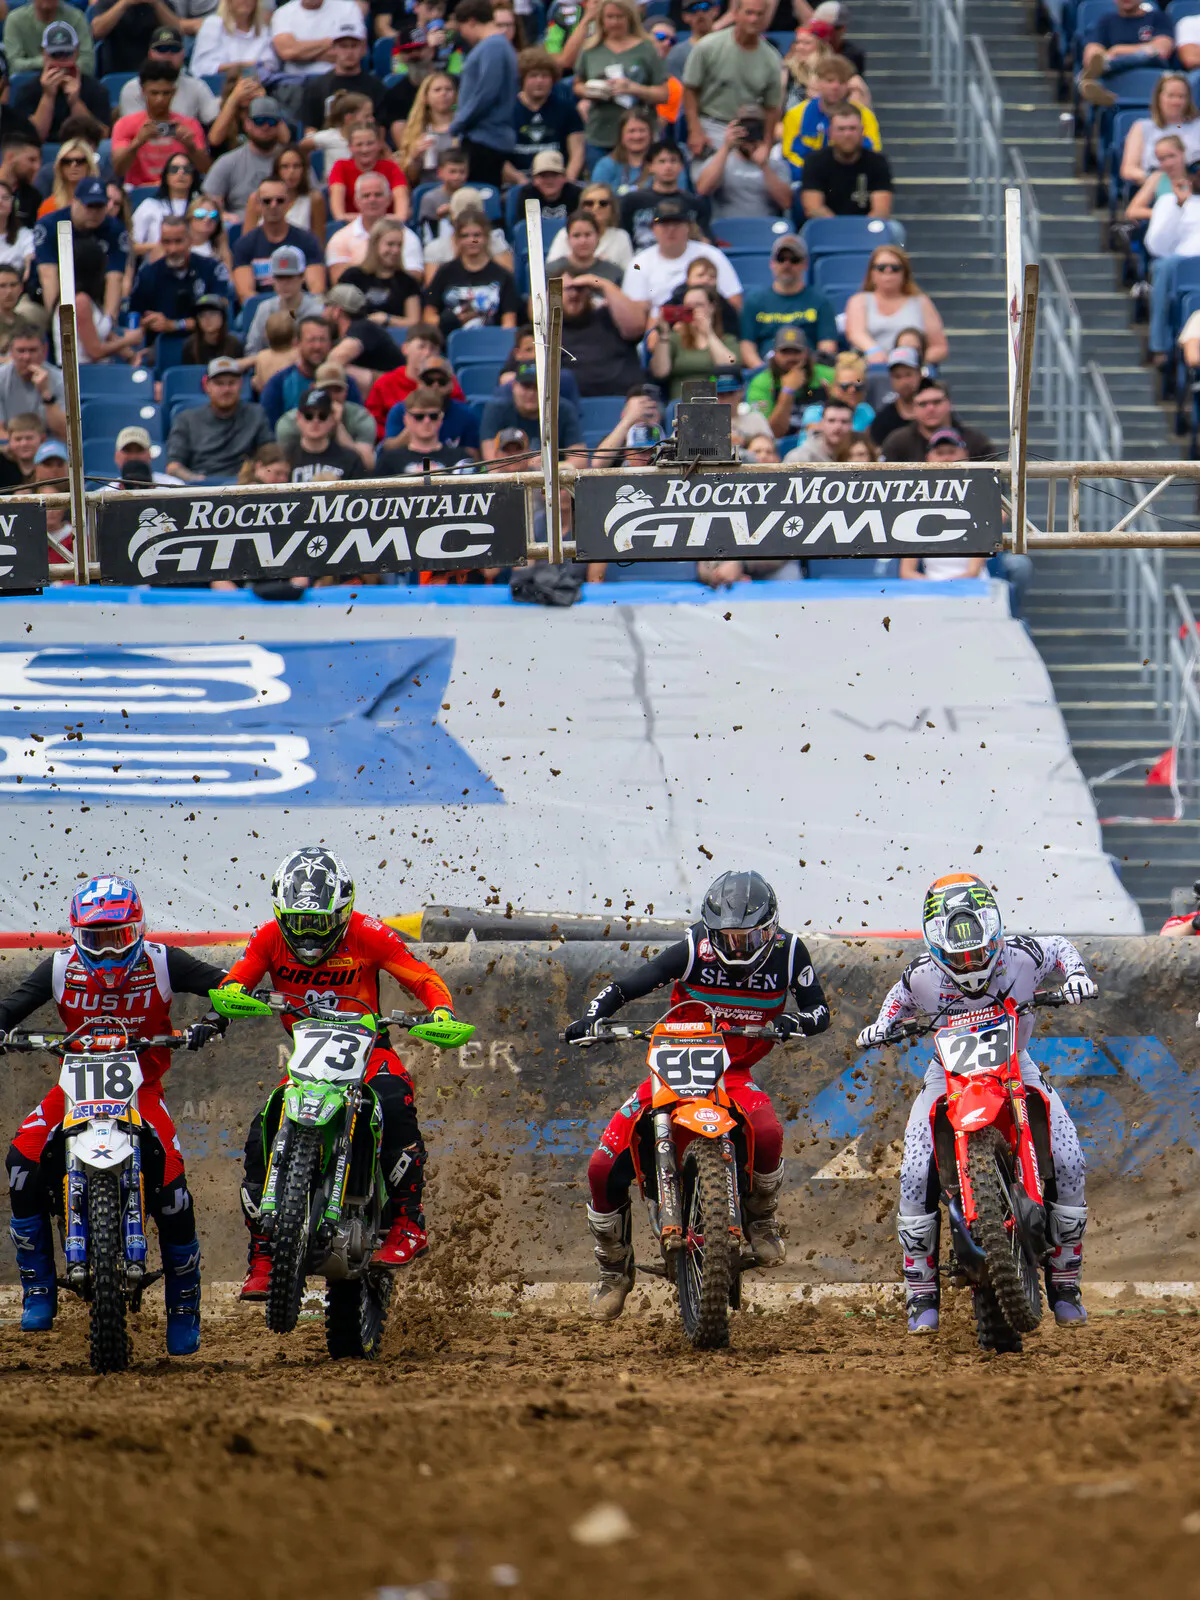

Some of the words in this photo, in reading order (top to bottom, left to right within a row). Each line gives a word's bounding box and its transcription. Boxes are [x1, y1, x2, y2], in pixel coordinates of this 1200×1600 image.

[661, 480, 777, 507] ROCKY
[780, 477, 972, 505] MOUNTAIN
[184, 501, 300, 530] ROCKY
[304, 493, 496, 525] MOUNTAIN
[65, 991, 153, 1011] JUST1
[230, 1004, 257, 1012] CIRCUIT
[950, 1005, 996, 1020] RENTHAL
[951, 1012, 996, 1028] RENTHAL
[425, 1031, 451, 1039] CIRCUIT
[298, 1031, 361, 1072] 73
[949, 1029, 1009, 1076] 23
[656, 1048, 723, 1086] 89
[68, 1062, 134, 1101] 118
[330, 1182, 343, 1203] TOP
